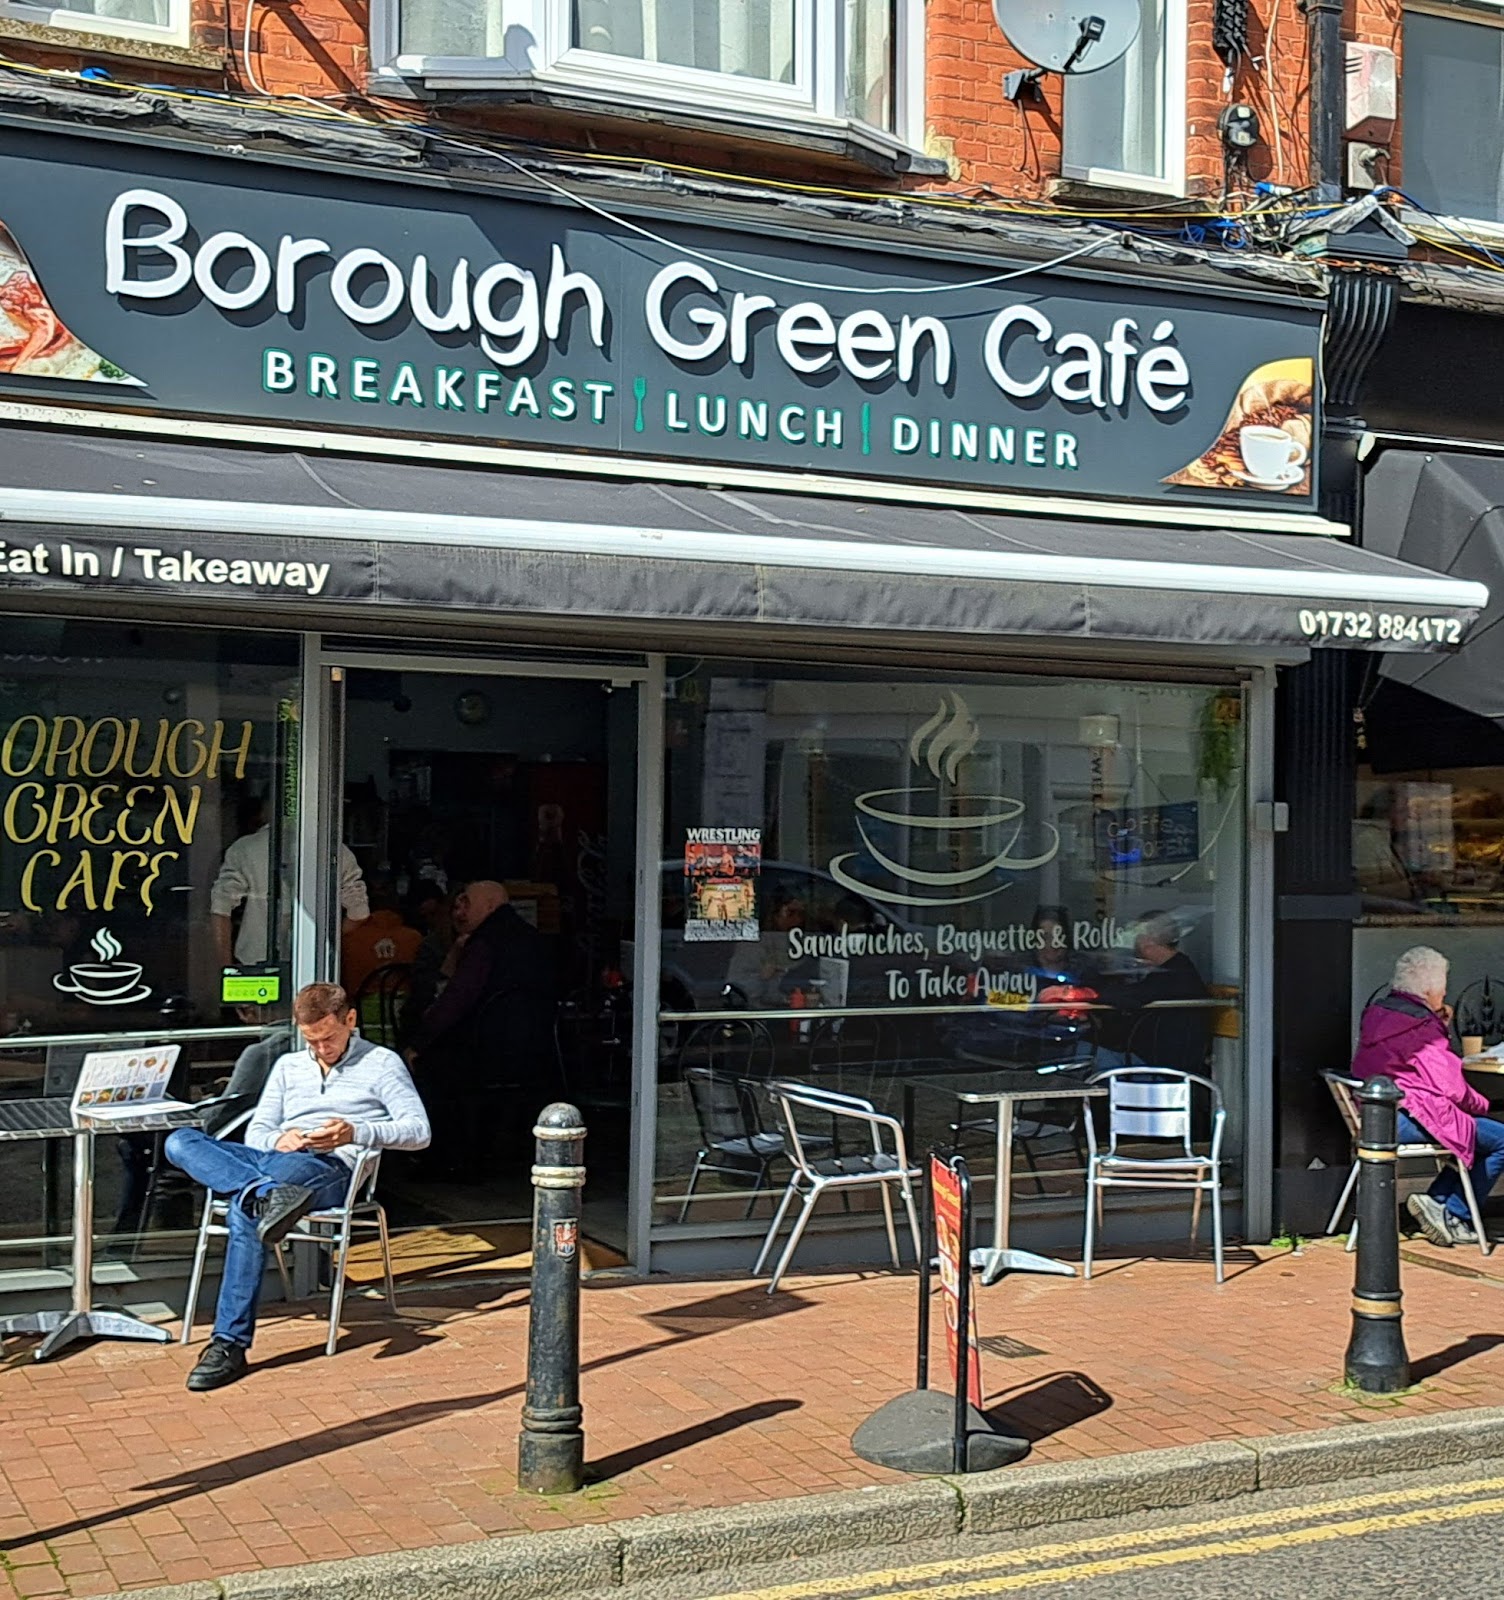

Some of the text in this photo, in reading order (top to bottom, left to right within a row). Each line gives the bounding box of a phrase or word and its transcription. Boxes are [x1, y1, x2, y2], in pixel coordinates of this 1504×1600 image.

[105, 188, 1192, 412] Borough Green Café
[264, 349, 1079, 469] BREAKFAST LUNCH DINNER
[60, 544, 99, 576] In
[111, 547, 125, 578] /
[134, 548, 331, 595] Takeaway
[1299, 610, 1462, 644] 01732 884172
[1, 715, 253, 779] OROUGH
[4, 782, 201, 845] GREEN
[686, 828, 761, 841] WRESTLING
[21, 849, 180, 917] CAFE
[788, 923, 930, 961] Sandwiches,
[936, 924, 1046, 961] Baguettes
[1051, 928, 1067, 950] &
[1073, 917, 1124, 950] Rolls
[885, 965, 1037, 1003] To Take Away
